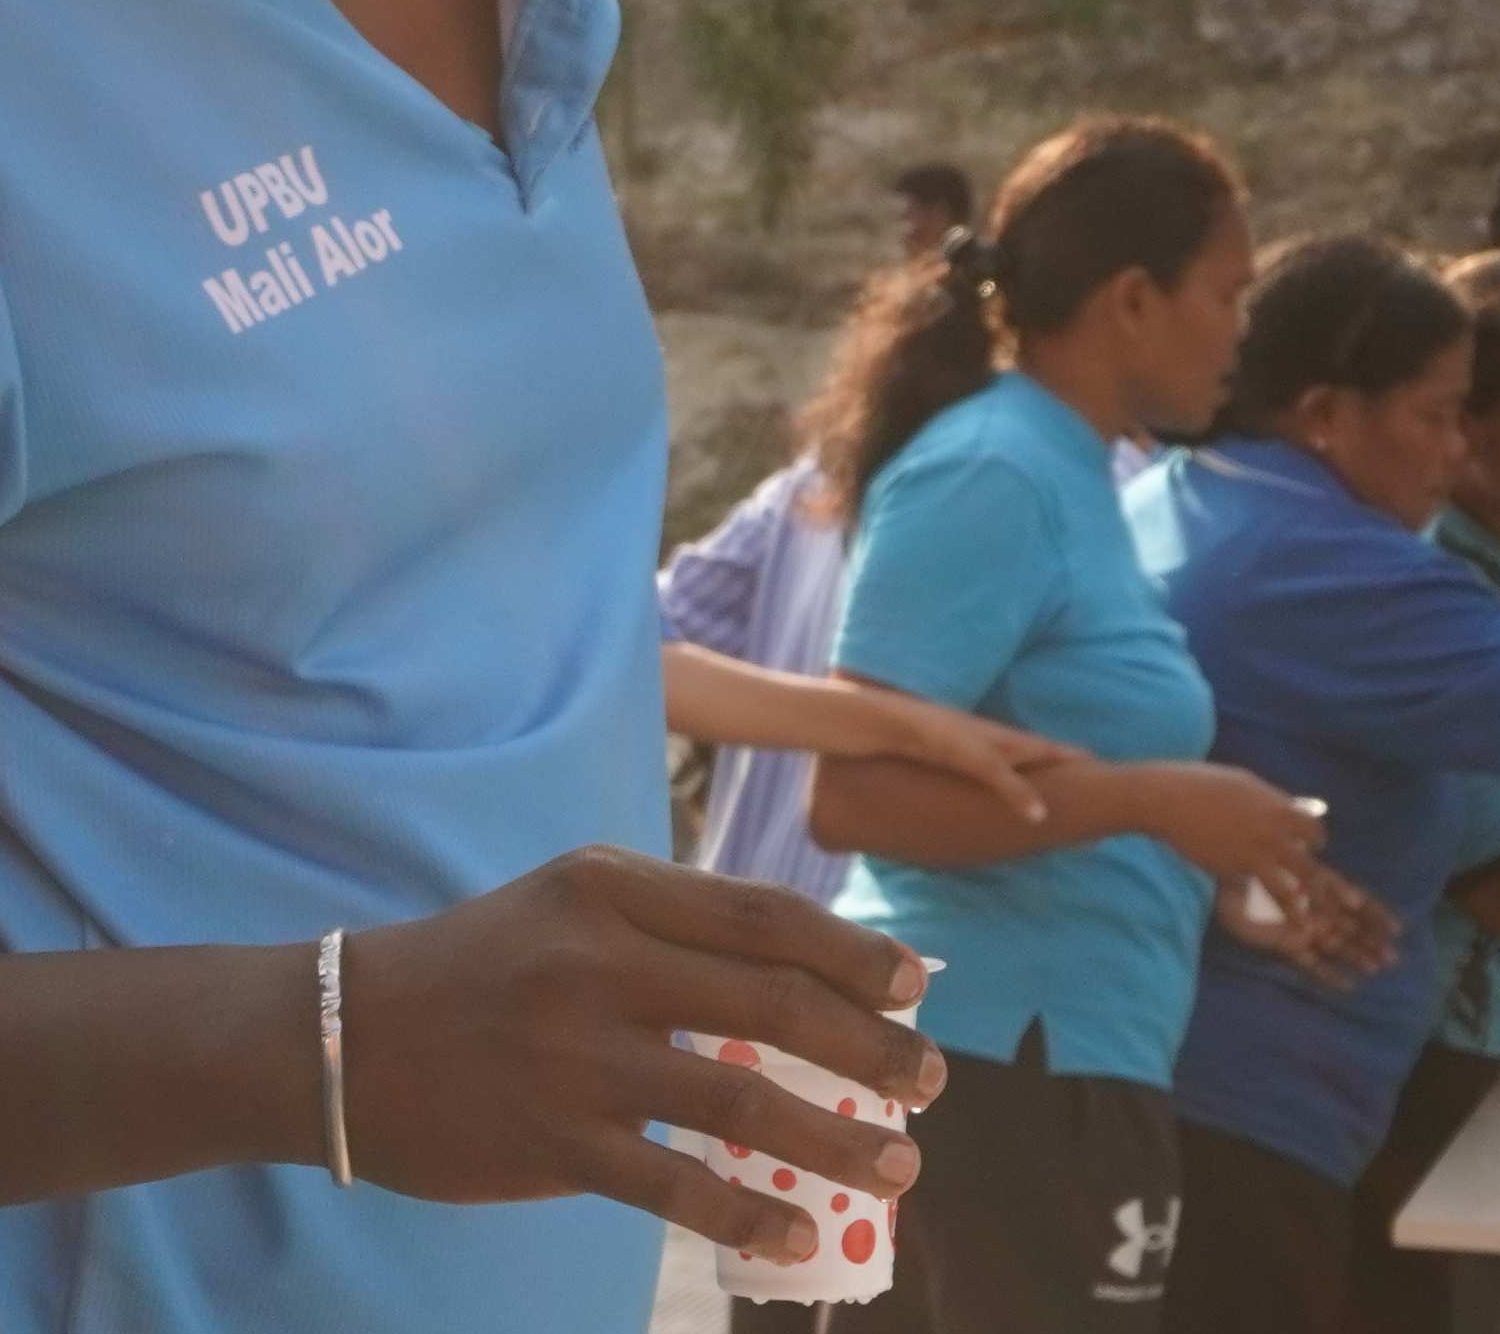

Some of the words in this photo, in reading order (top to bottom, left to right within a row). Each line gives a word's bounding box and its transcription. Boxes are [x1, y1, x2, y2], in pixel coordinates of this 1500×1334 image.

[200, 145, 330, 246] UPBU
[202, 241, 316, 334] Mali
[310, 208, 403, 286] Alor
